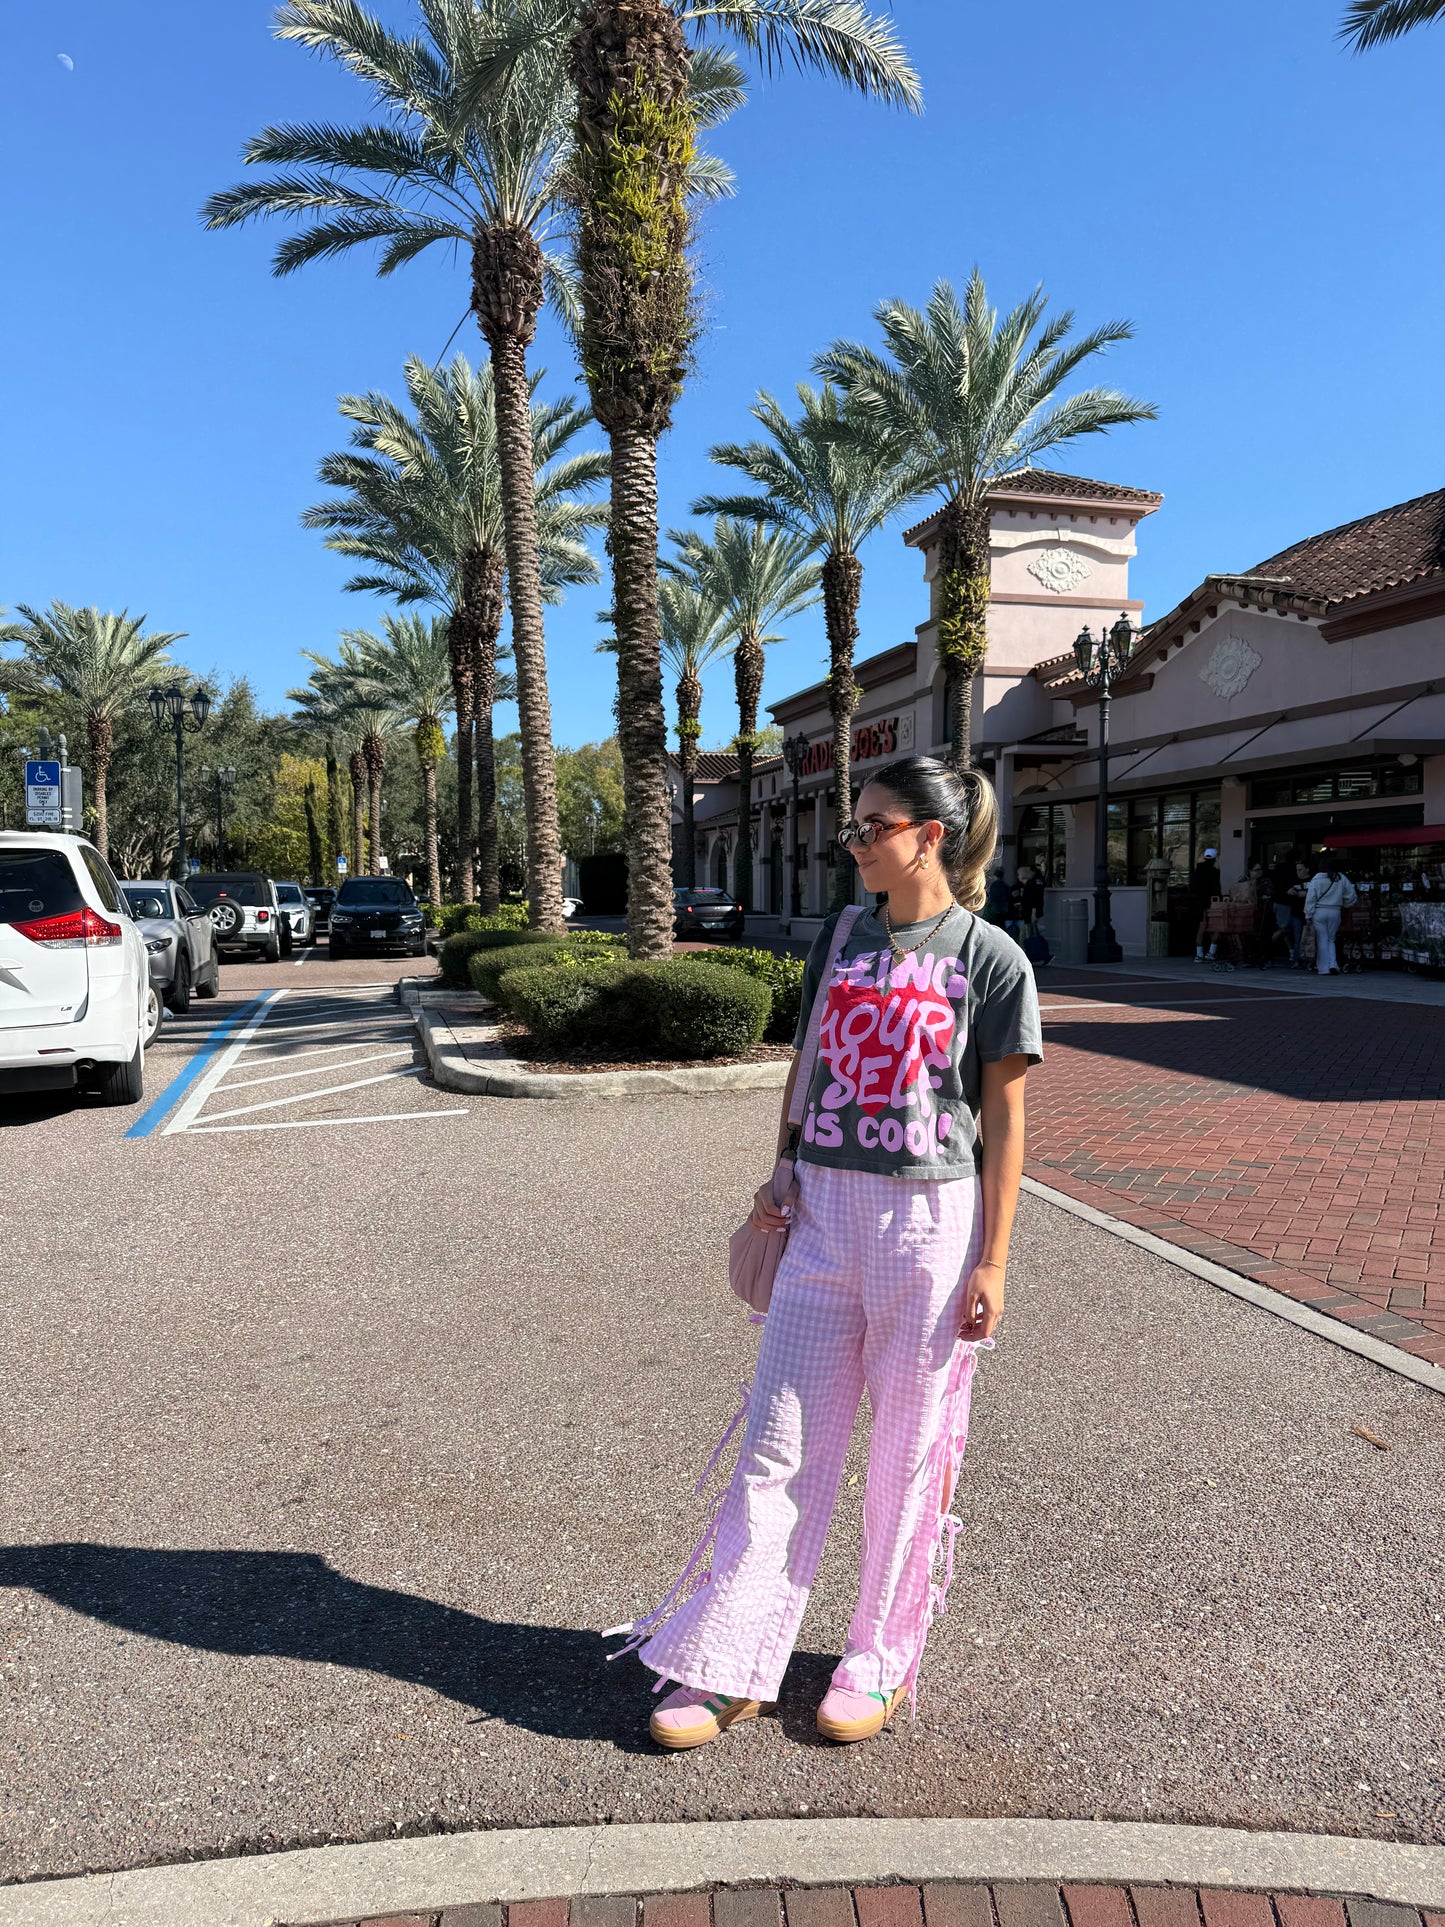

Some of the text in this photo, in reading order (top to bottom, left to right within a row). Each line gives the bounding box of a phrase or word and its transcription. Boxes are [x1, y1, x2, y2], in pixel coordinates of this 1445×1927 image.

[851, 716, 899, 761] JOE'S
[829, 950, 967, 998] BEING
[820, 995, 954, 1061] YOUR
[818, 1047, 951, 1118] SELF
[804, 1102, 844, 1148] is
